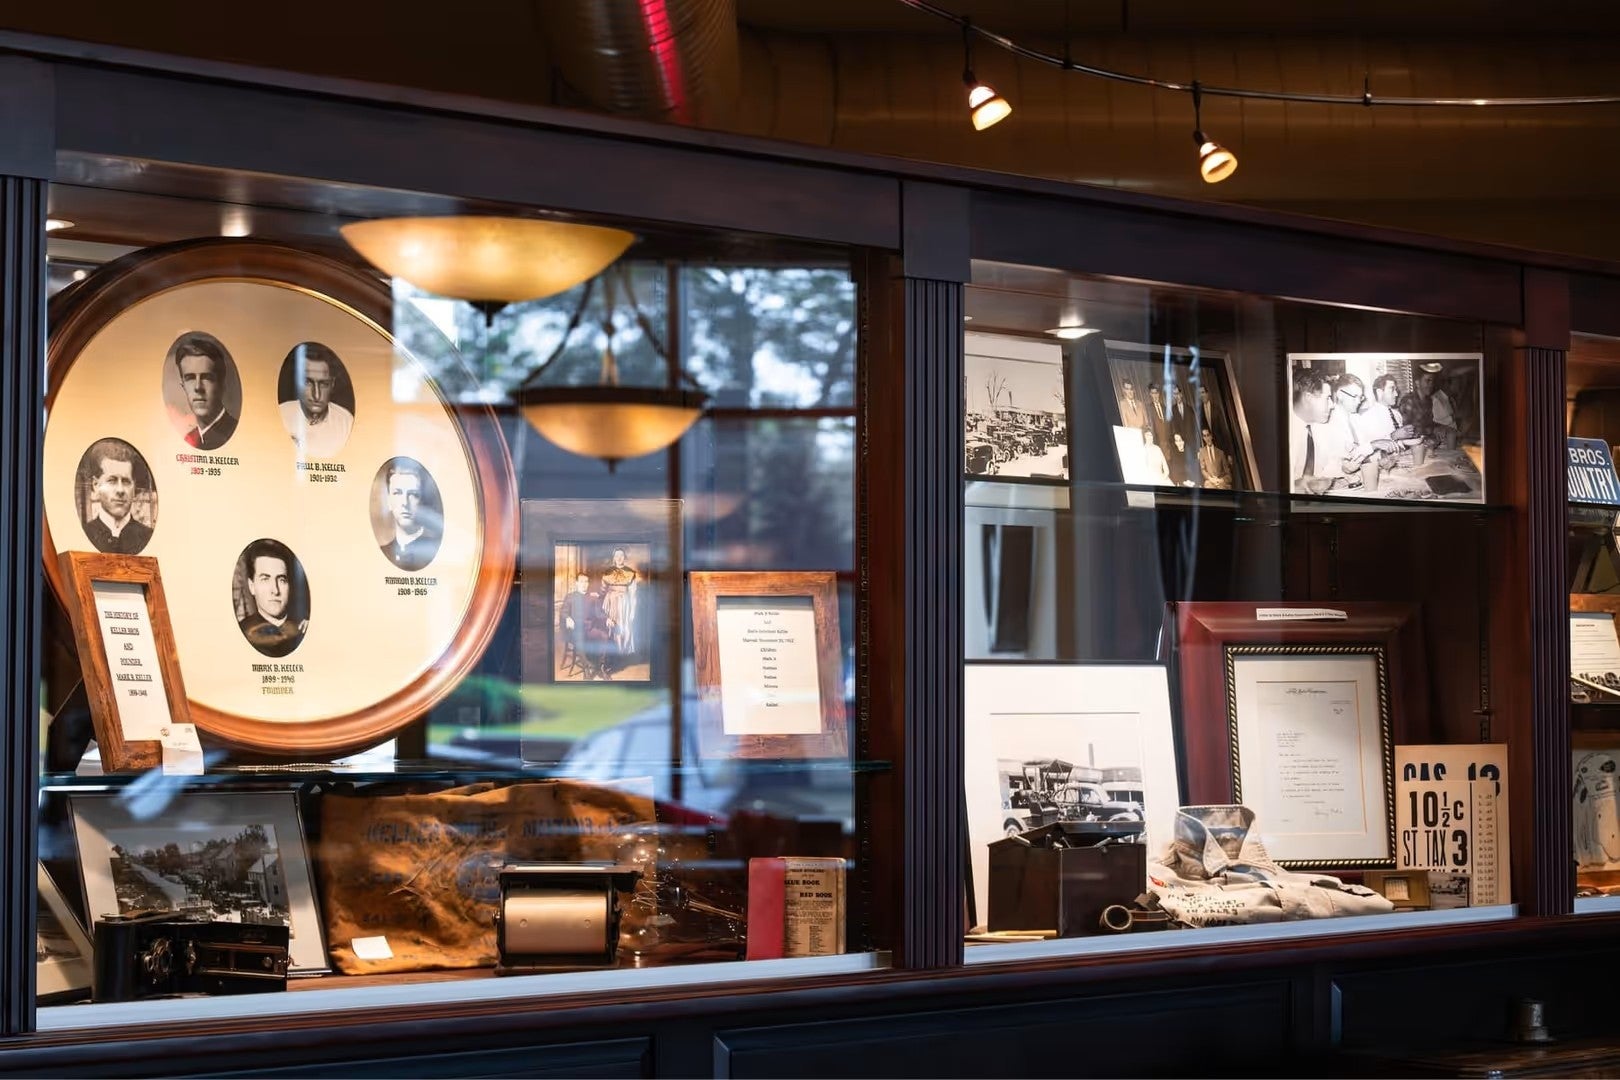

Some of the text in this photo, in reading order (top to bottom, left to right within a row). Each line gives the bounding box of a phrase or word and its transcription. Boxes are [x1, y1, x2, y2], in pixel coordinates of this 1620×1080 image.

[1568, 447, 1609, 465] BROS.
[1568, 466, 1617, 500] OUNTRY
[1425, 830, 1447, 867] TAX
[1452, 829, 1468, 867] 3
